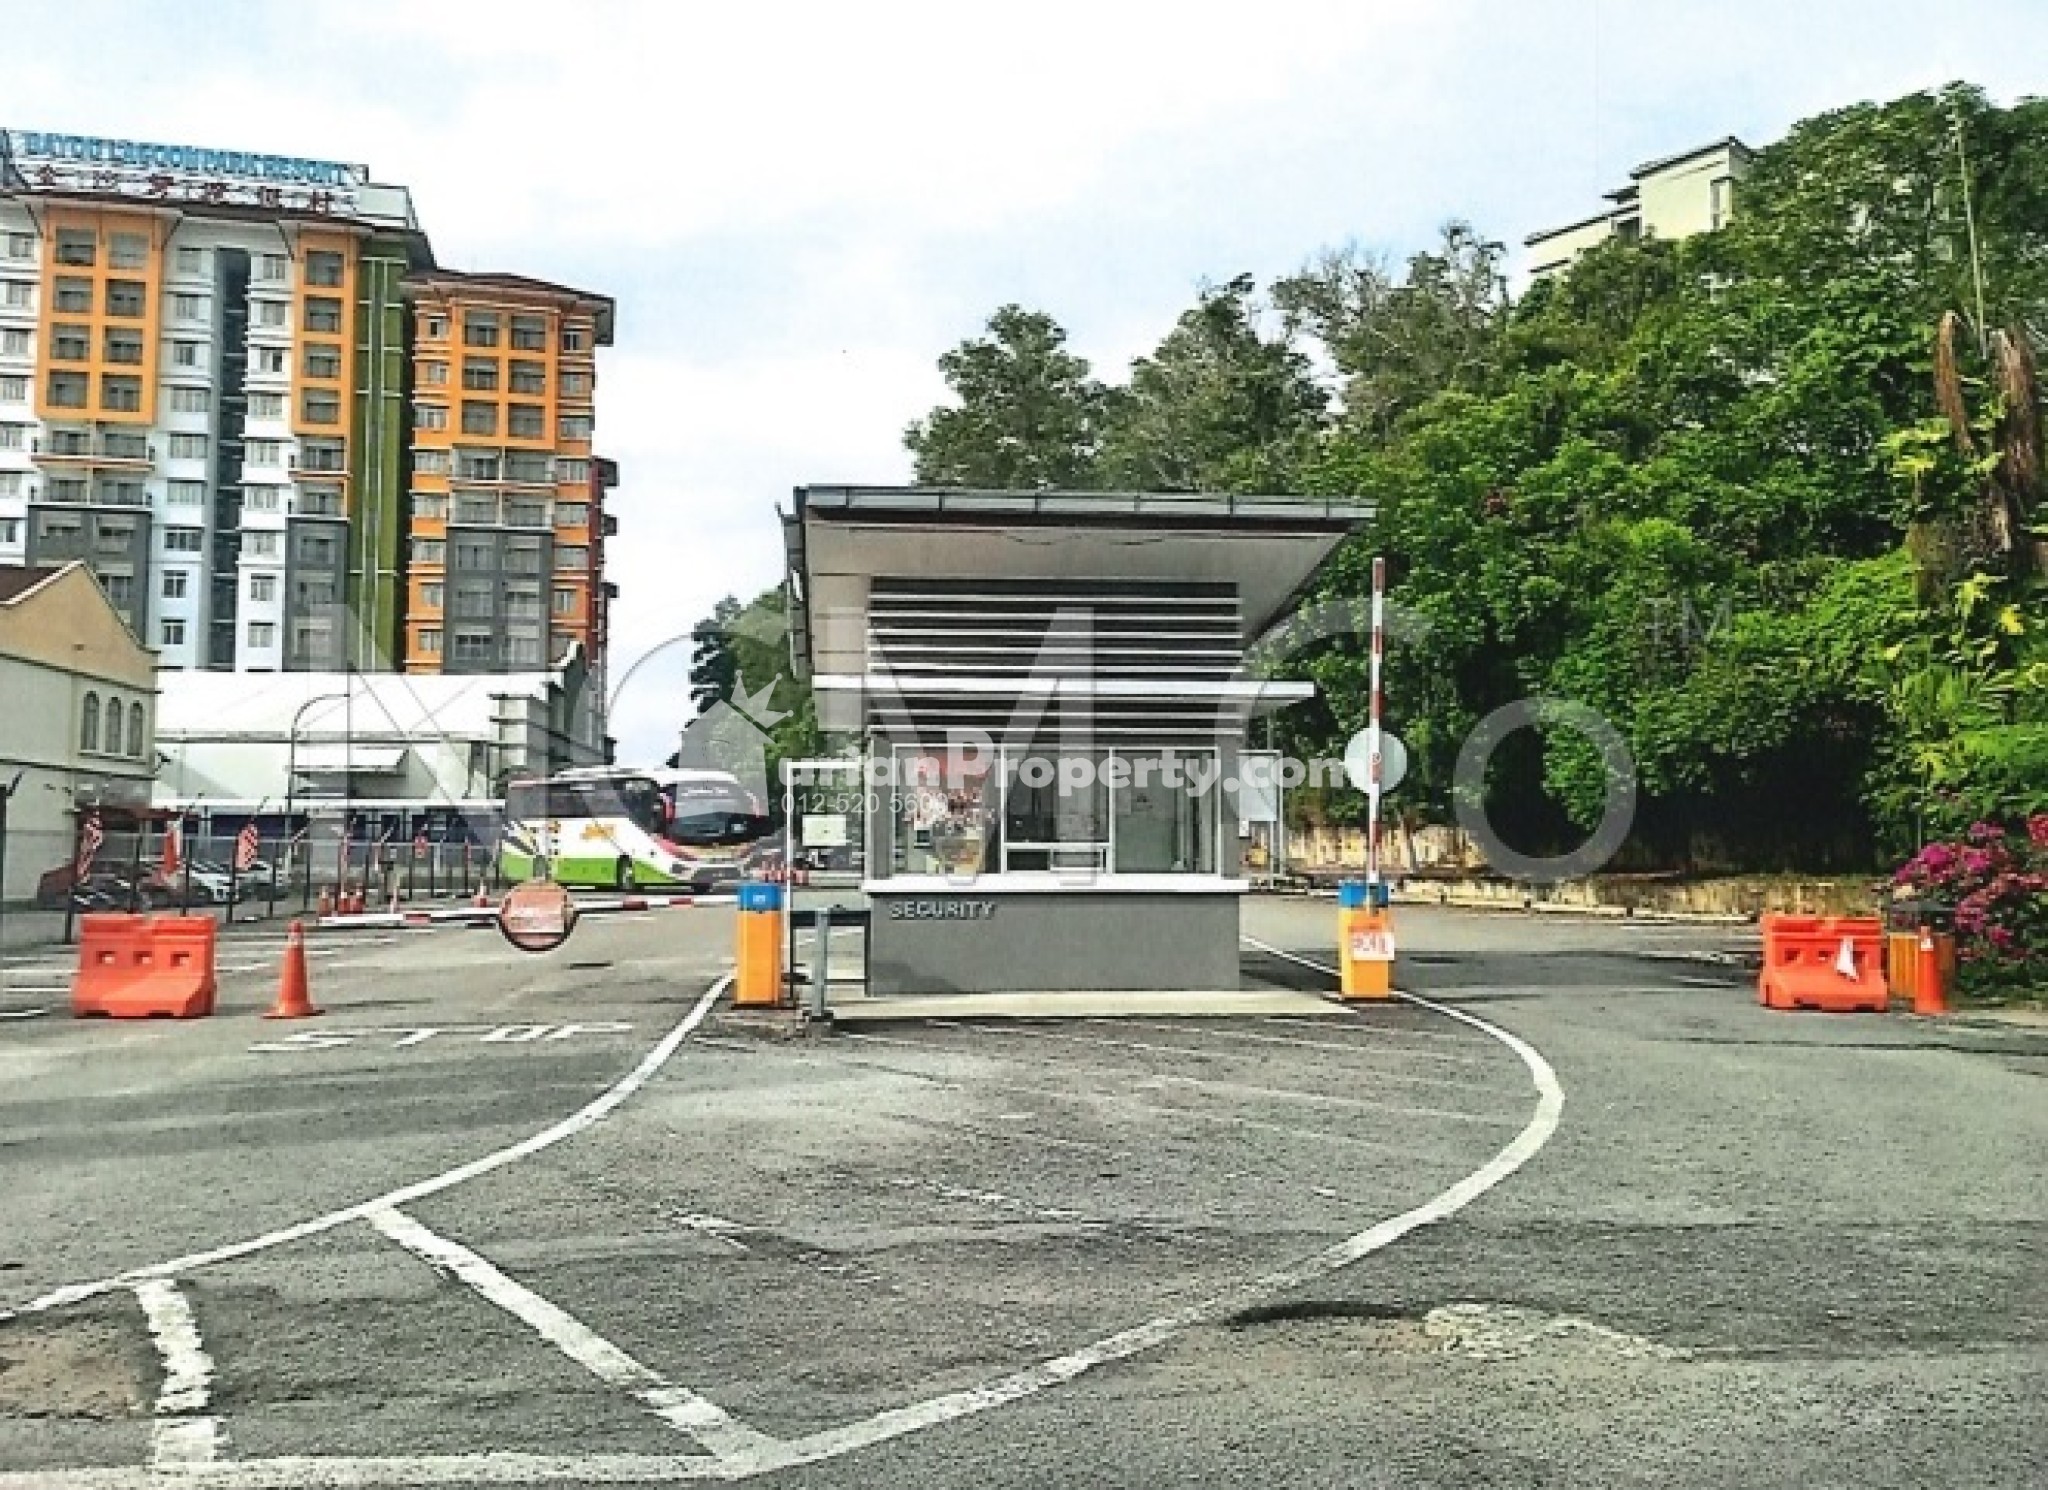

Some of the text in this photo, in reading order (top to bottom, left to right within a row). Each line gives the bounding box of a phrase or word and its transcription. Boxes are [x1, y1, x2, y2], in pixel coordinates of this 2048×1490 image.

[24, 132, 105, 160] BAYOU
[890, 900, 996, 919] SECURITY
[247, 1022, 634, 1053] STOP
